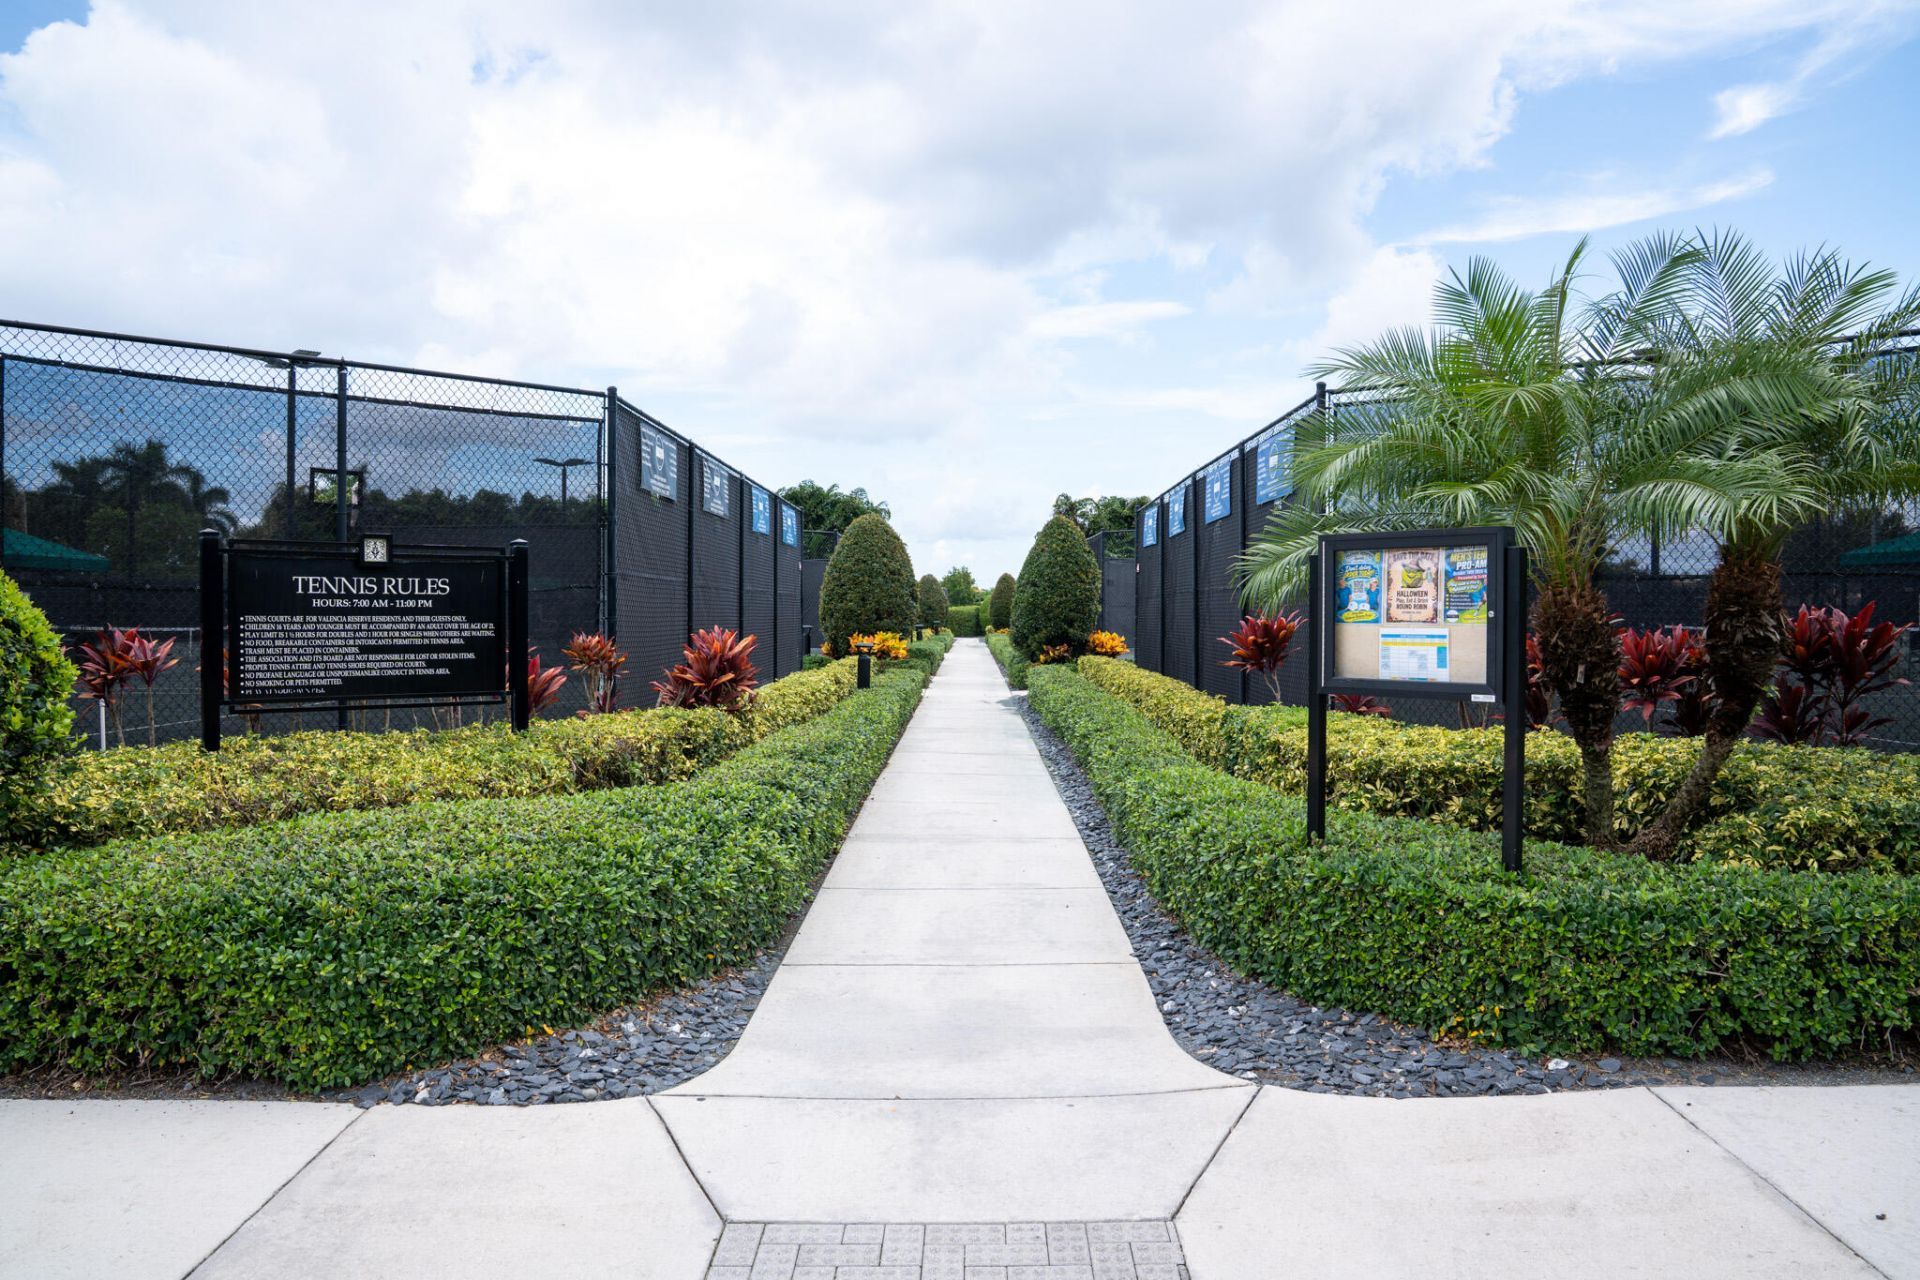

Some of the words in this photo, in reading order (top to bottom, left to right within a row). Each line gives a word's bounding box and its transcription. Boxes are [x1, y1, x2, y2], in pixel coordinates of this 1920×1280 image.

[1456, 560, 1487, 570] PRO-AM
[292, 576, 378, 595] TENNIS
[382, 577, 450, 595] RULES
